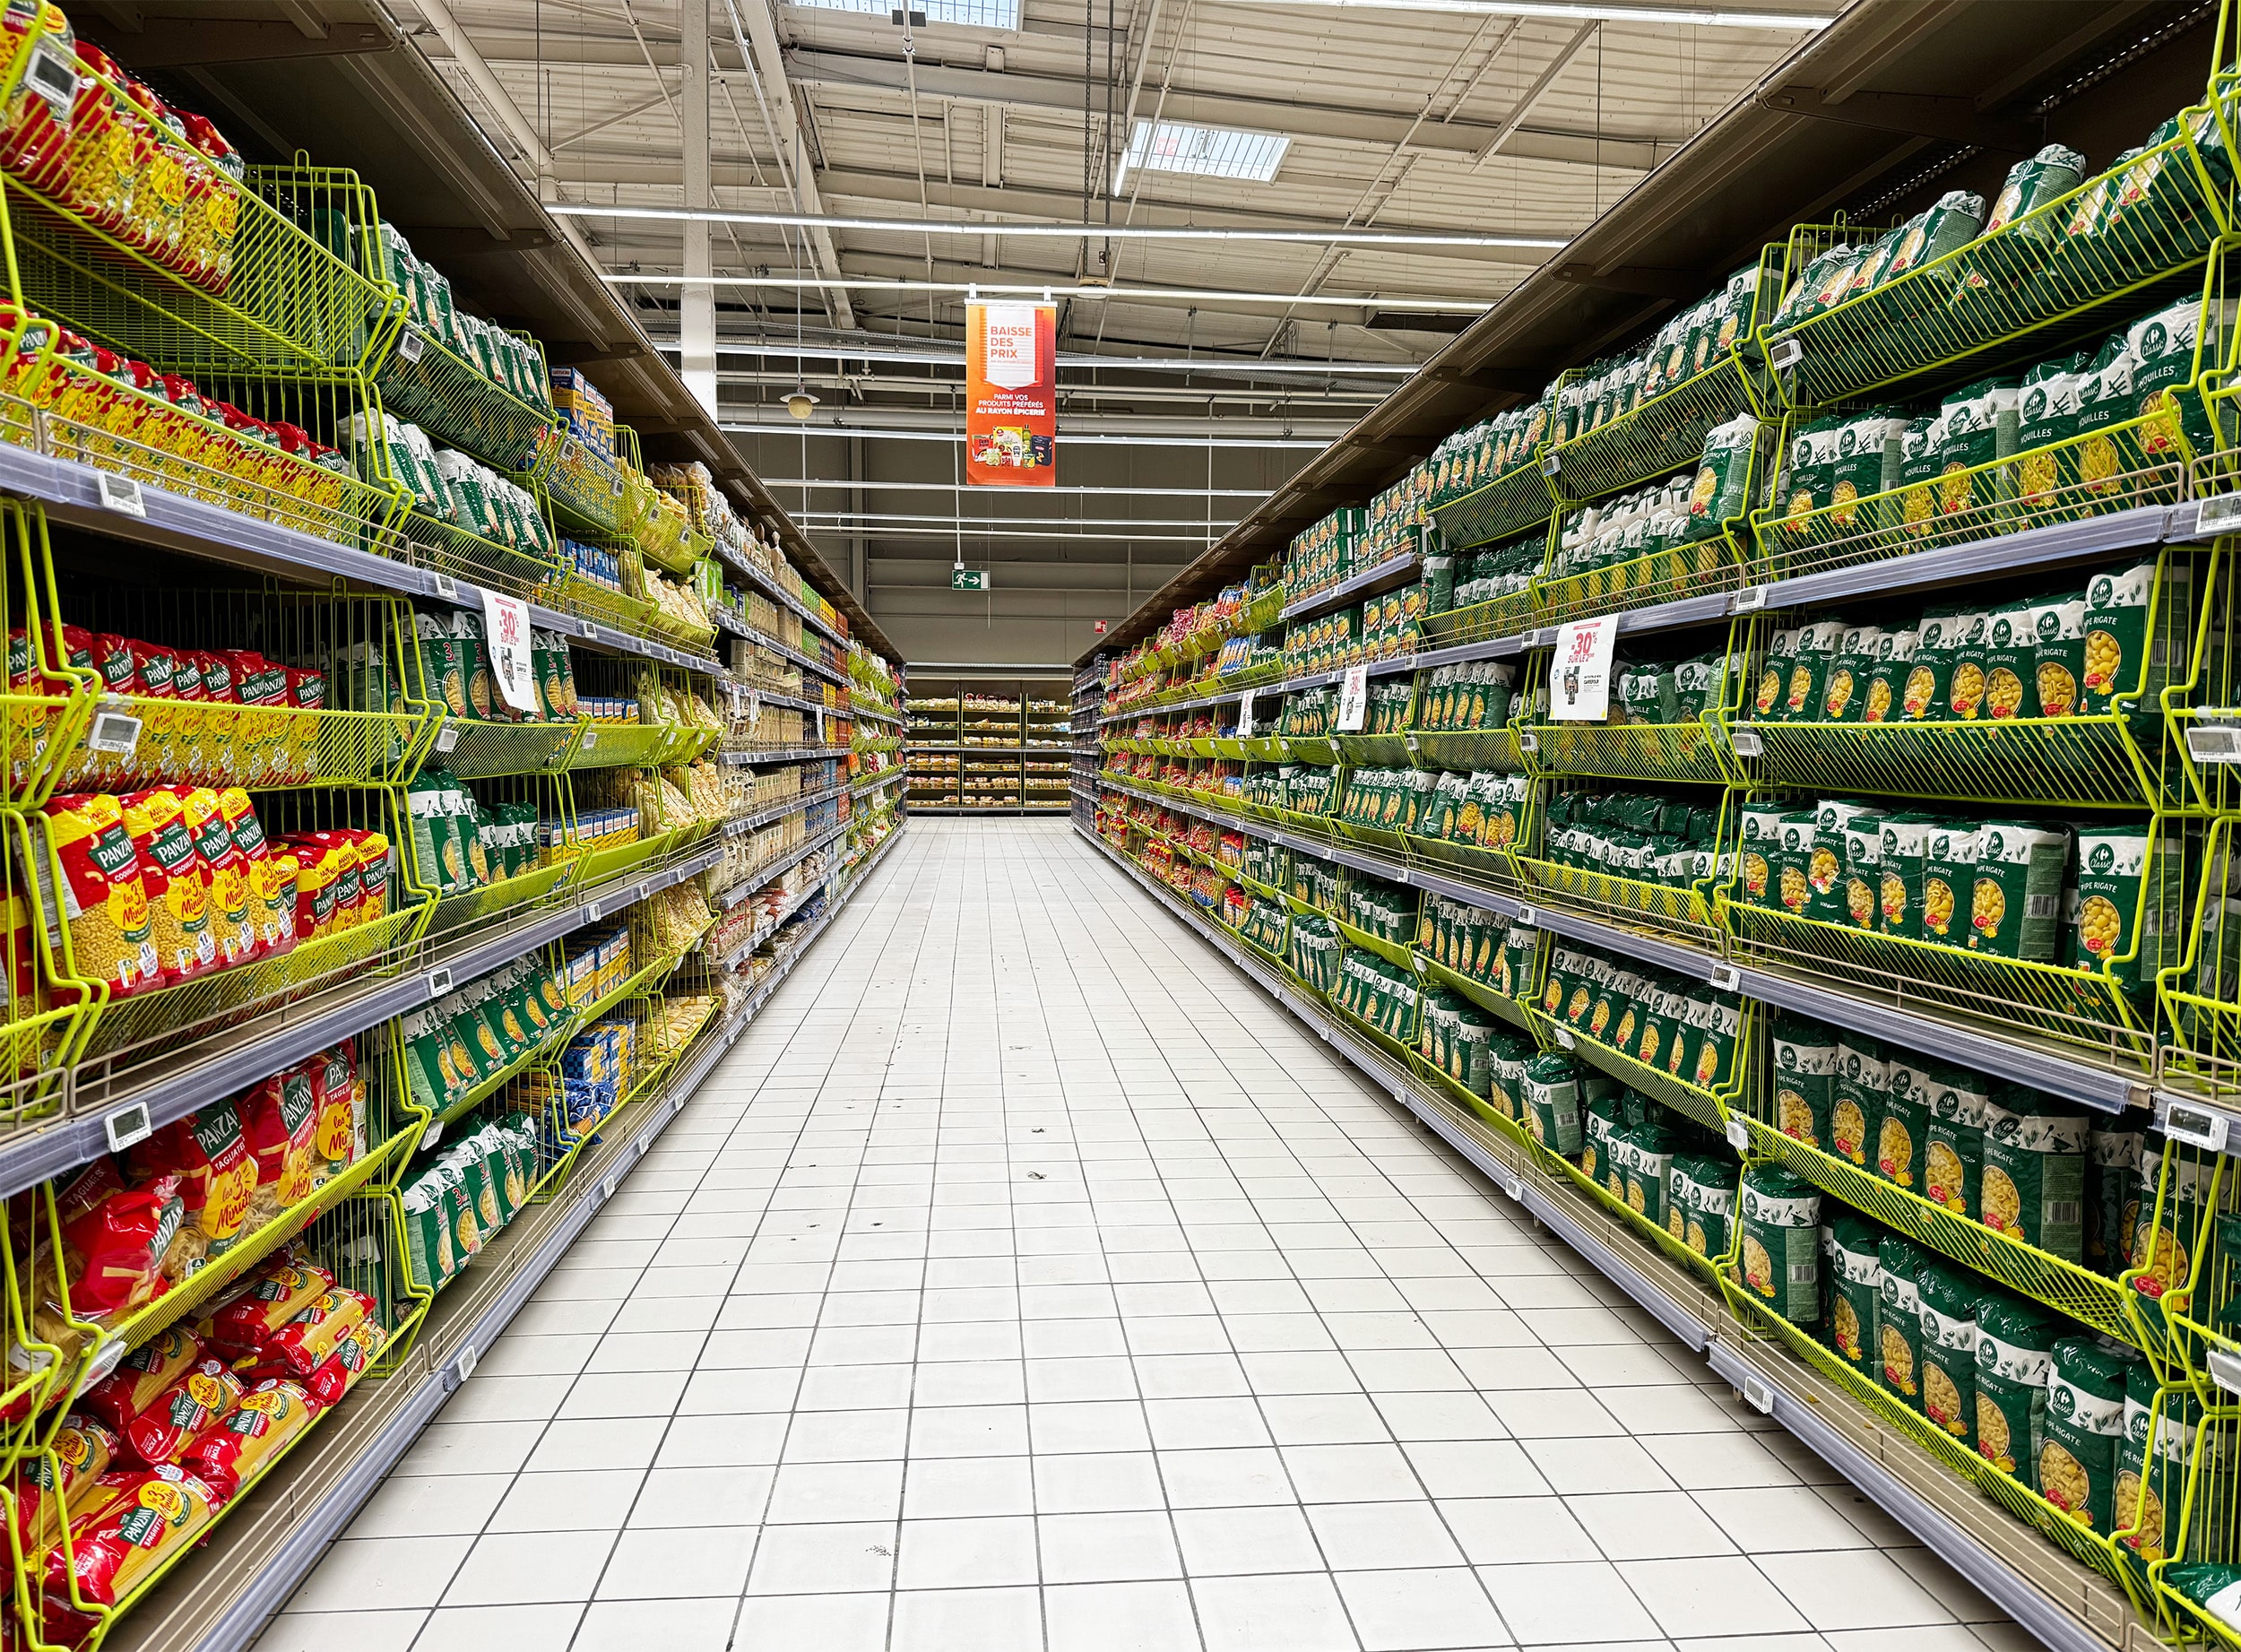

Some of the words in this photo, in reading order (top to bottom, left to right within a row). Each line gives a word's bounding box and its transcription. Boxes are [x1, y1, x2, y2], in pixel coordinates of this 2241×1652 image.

[991, 326, 1032, 336] BAISSE
[991, 338, 1014, 347] DES
[2141, 339, 2166, 356] Classic
[991, 349, 1017, 359] PRIX
[1012, 400, 1043, 408] PRÉFÉRÉS
[2023, 405, 2045, 418] Classic
[2091, 593, 2110, 602] Classic
[2094, 616, 2118, 626] RIGATE
[2038, 627, 2058, 636] Classic
[443, 642, 454, 661] 3
[1966, 650, 1986, 660] RIGATE
[2045, 648, 2068, 658] RIGATE
[1568, 654, 1579, 663] SUR
[1998, 654, 2018, 664] RIGATE
[264, 861, 273, 878] 3
[2090, 858, 2112, 869] Classic
[1934, 865, 1952, 877] RIGATE
[1986, 866, 2006, 878] RIGATE
[189, 877, 197, 896] 3
[2094, 882, 2117, 893] RIGATE
[131, 884, 141, 905] 3
[334, 1115, 345, 1129] les
[1938, 1127, 1958, 1141] RIGATE
[1993, 1150, 2014, 1165] RIGATE
[222, 1187, 232, 1202] les
[233, 1171, 244, 1201] 3
[453, 1188, 463, 1206] 3
[1980, 1374, 2004, 1394] RIGATE
[2055, 1426, 2081, 1446] RIGATE
